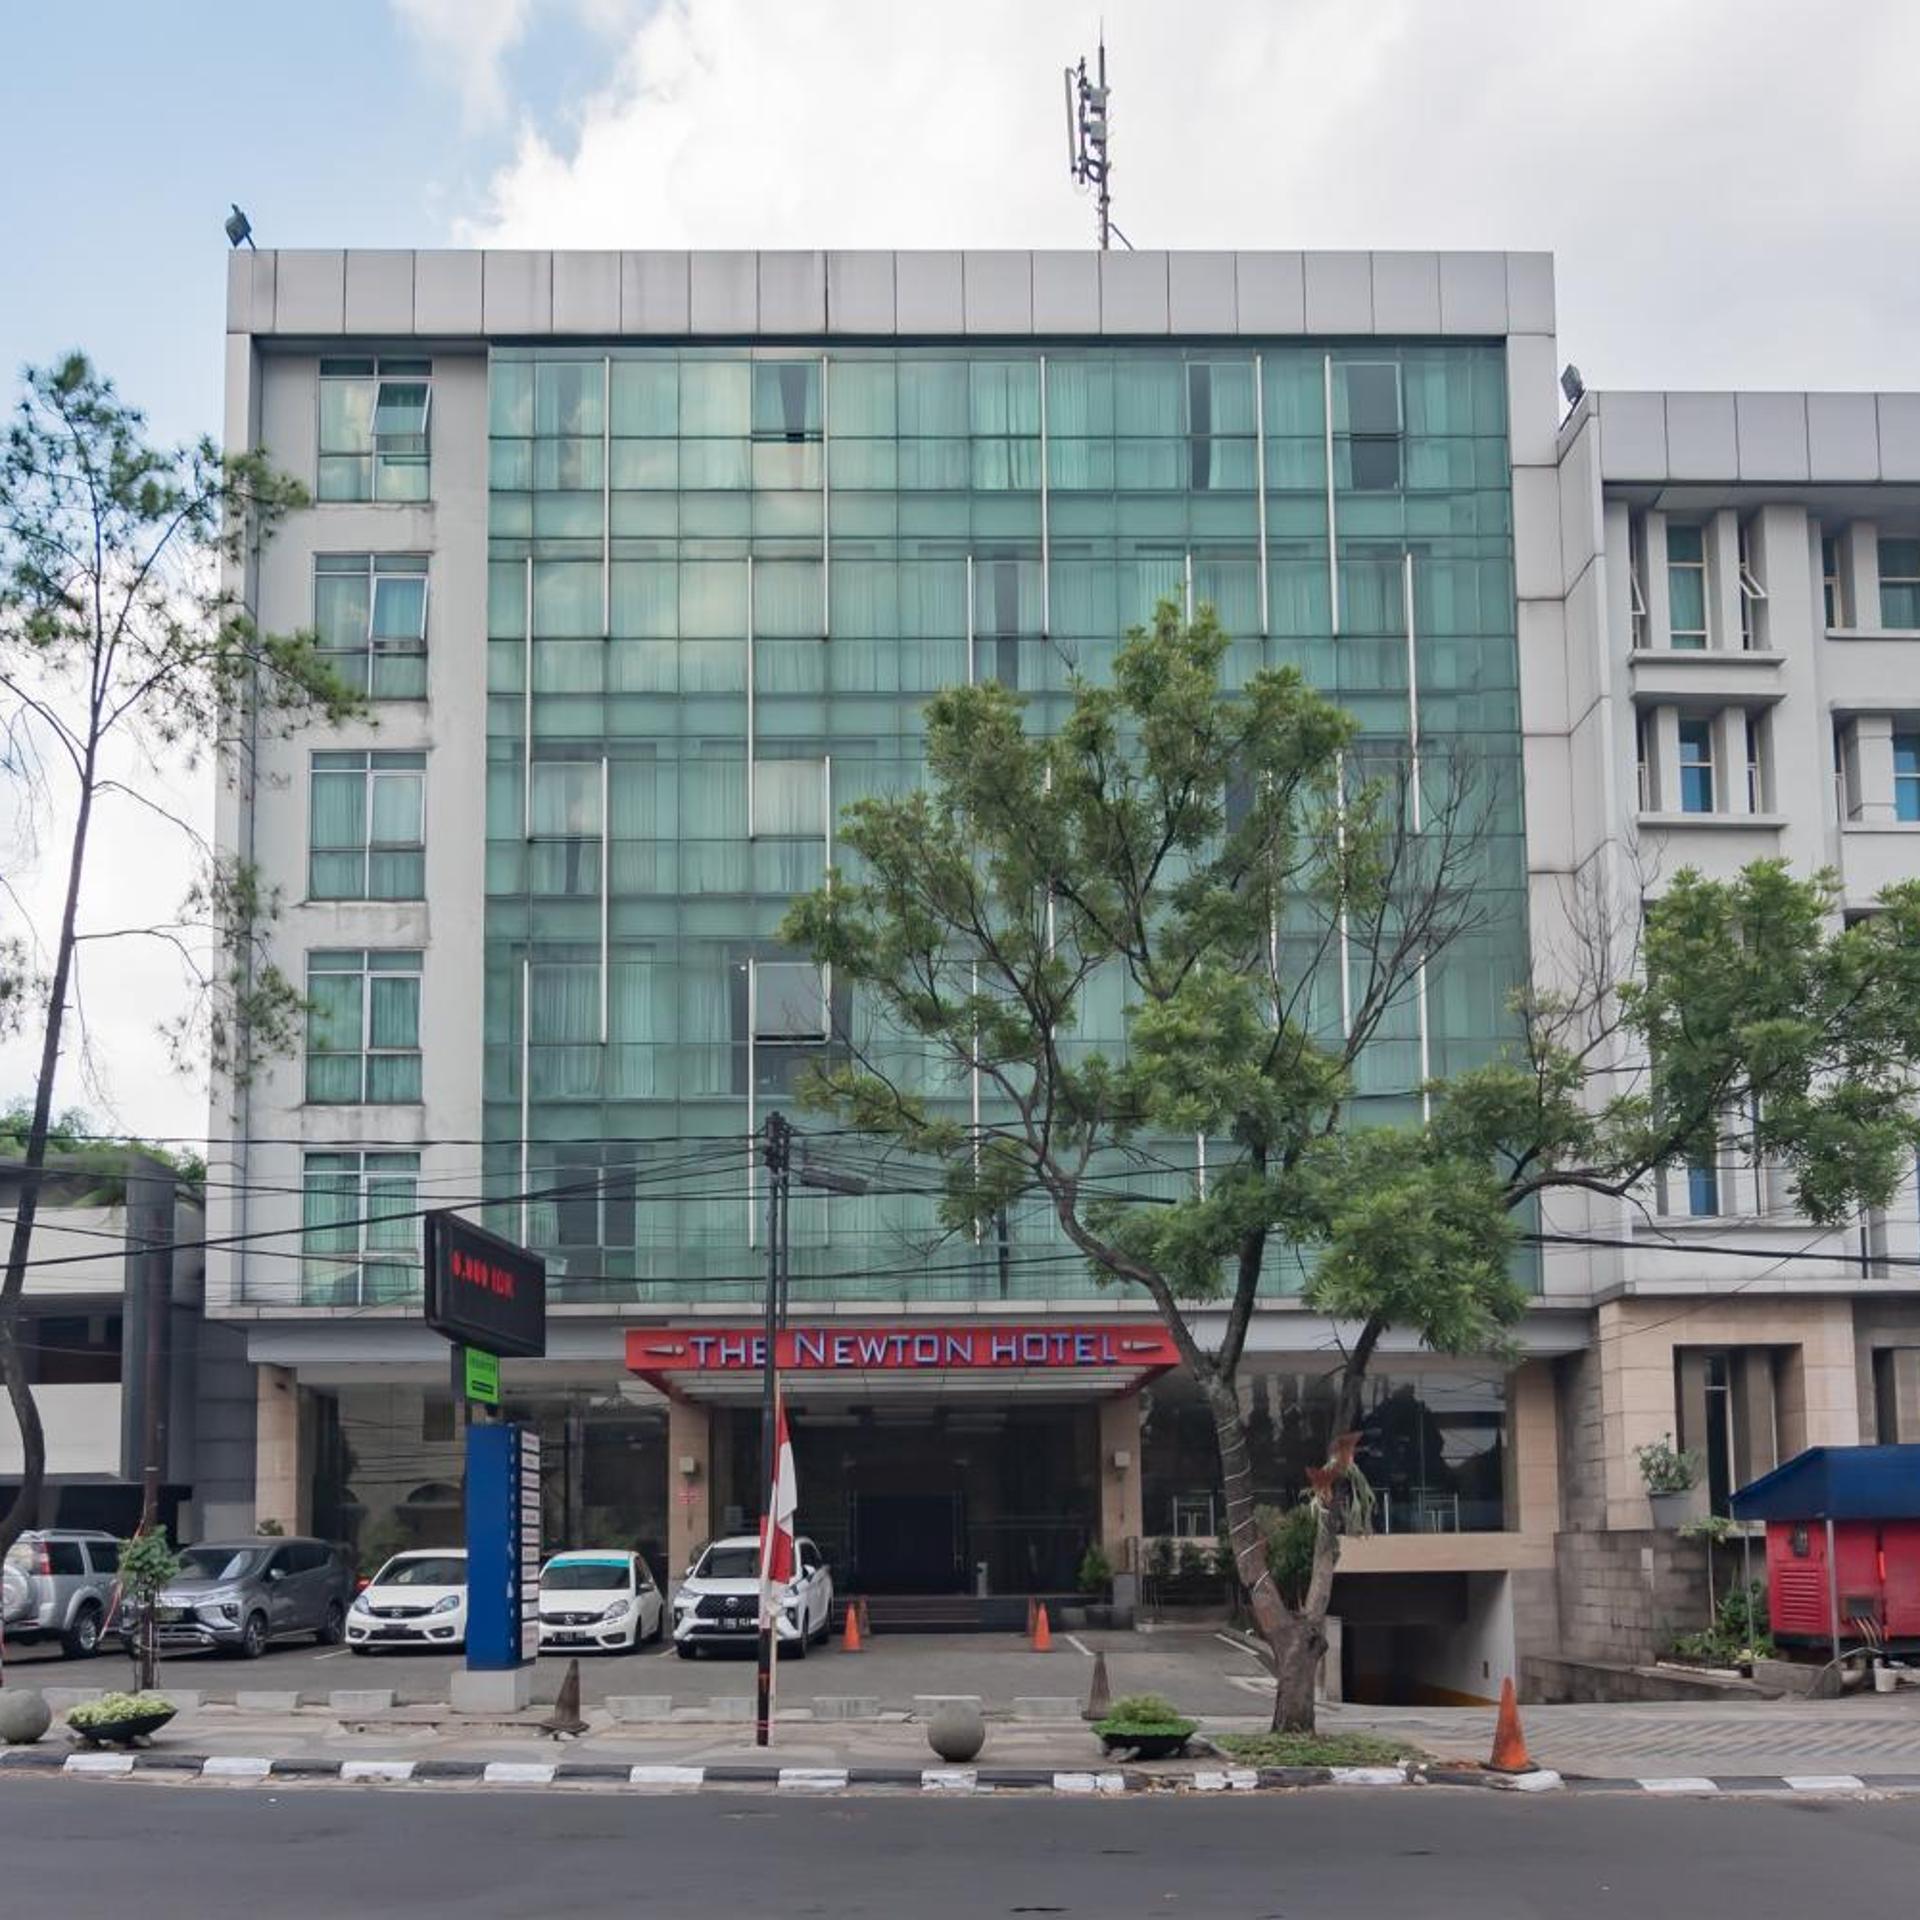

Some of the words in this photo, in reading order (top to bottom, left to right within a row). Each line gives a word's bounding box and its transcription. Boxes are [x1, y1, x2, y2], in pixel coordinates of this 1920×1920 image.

[688, 1335, 768, 1365] THE
[795, 1330, 972, 1364] NEWTON
[992, 1333, 1117, 1362] HOTEL
